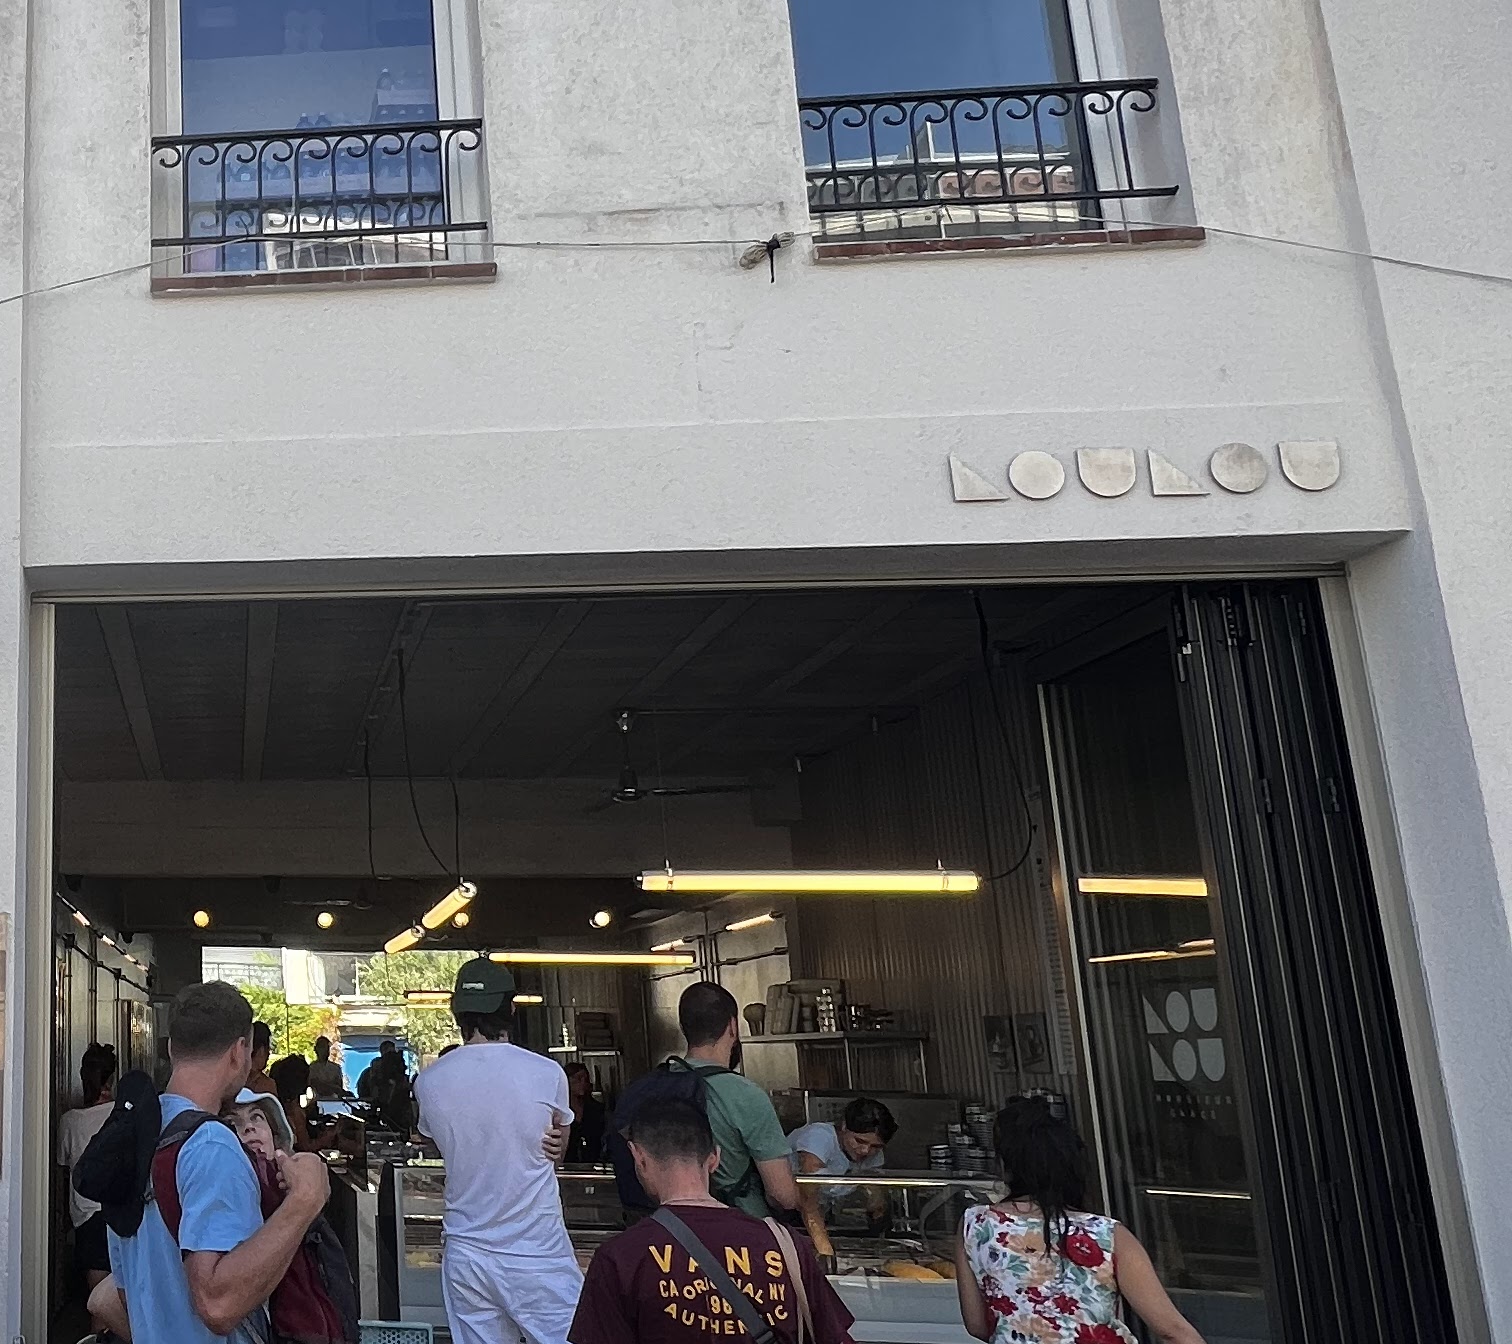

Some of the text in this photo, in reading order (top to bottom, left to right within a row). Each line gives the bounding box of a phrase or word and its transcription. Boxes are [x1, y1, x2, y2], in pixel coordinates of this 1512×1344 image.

[948, 439, 1342, 504] LOULOU
[1142, 987, 1218, 1034] LOU
[1148, 1037, 1226, 1082] LOU
[682, 1276, 764, 1305] ORINAL
[663, 1302, 789, 1335] AUTHENIC
